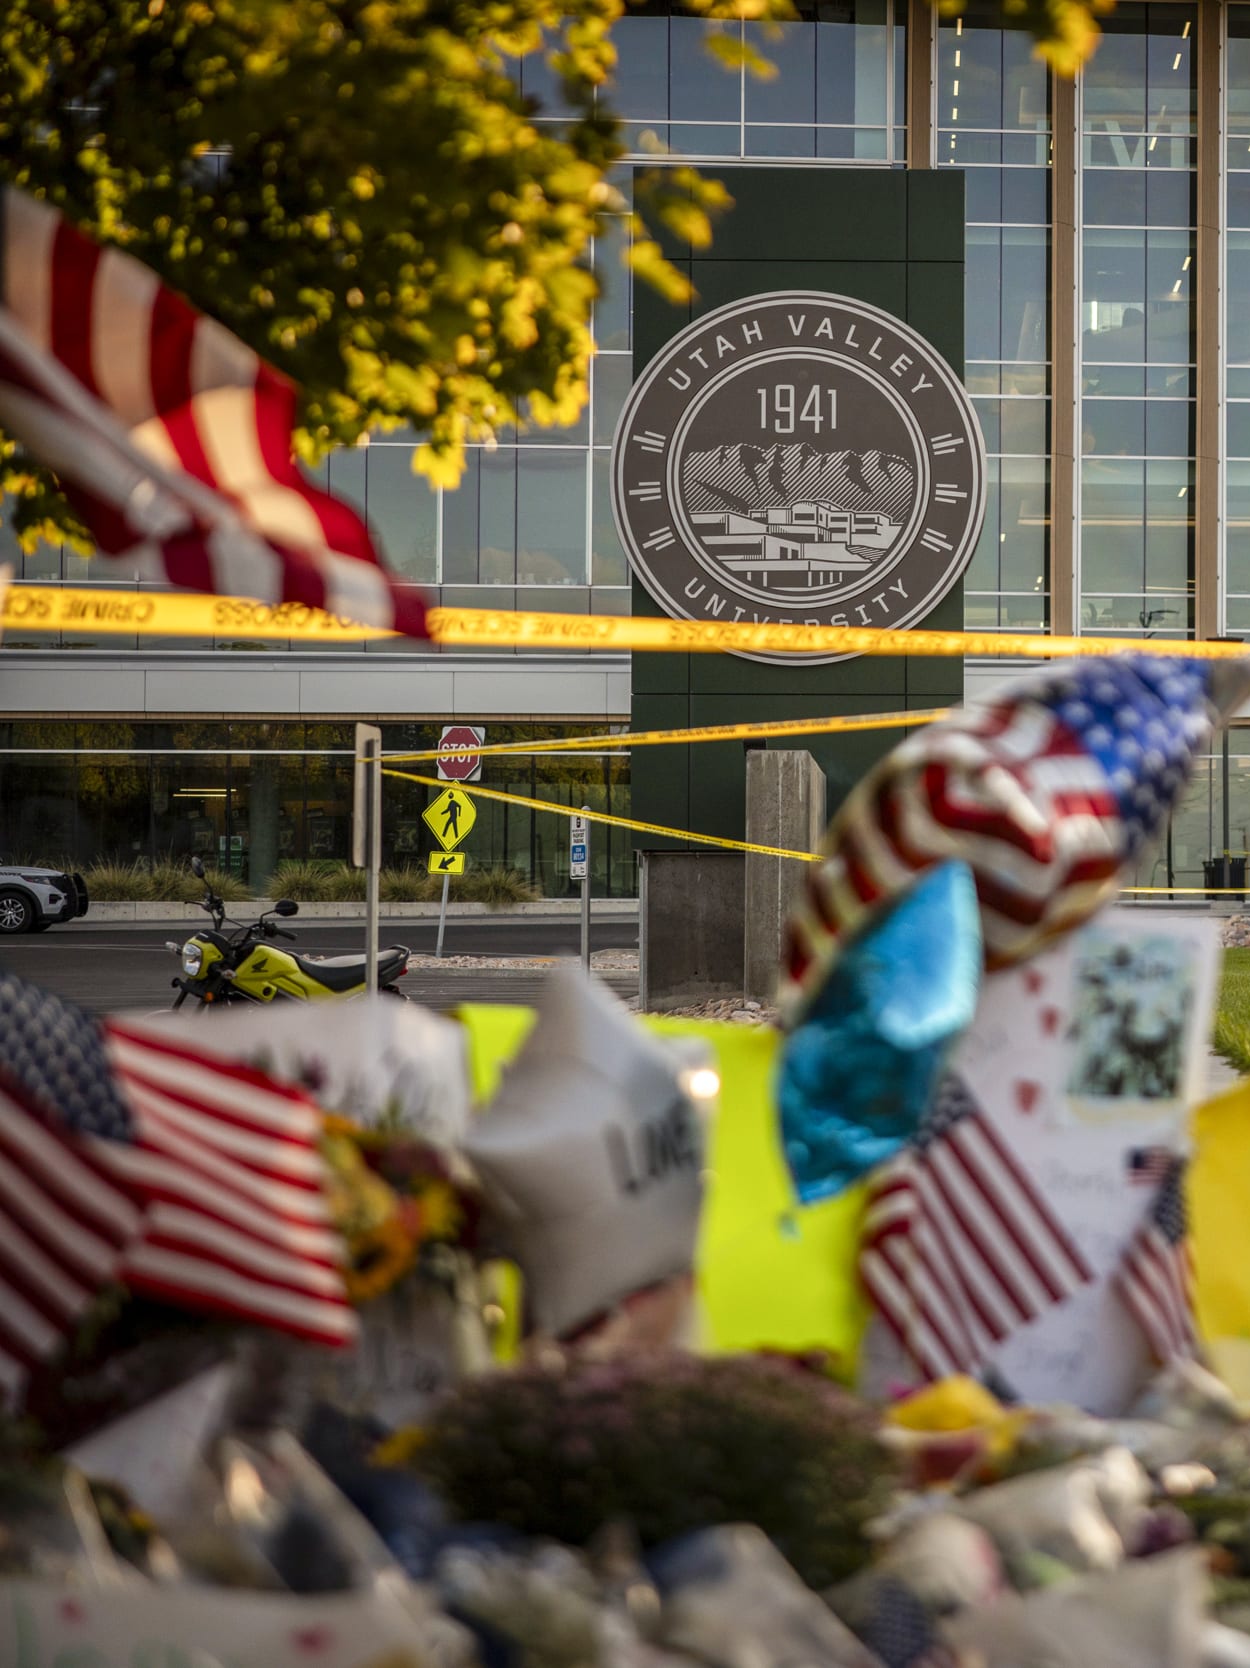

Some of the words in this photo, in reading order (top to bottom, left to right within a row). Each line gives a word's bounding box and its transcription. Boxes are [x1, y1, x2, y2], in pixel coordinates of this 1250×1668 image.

[668, 320, 763, 391] UTAH
[787, 315, 934, 395] VALLEY
[757, 384, 837, 433] 1941
[440, 743, 477, 763] STOP
